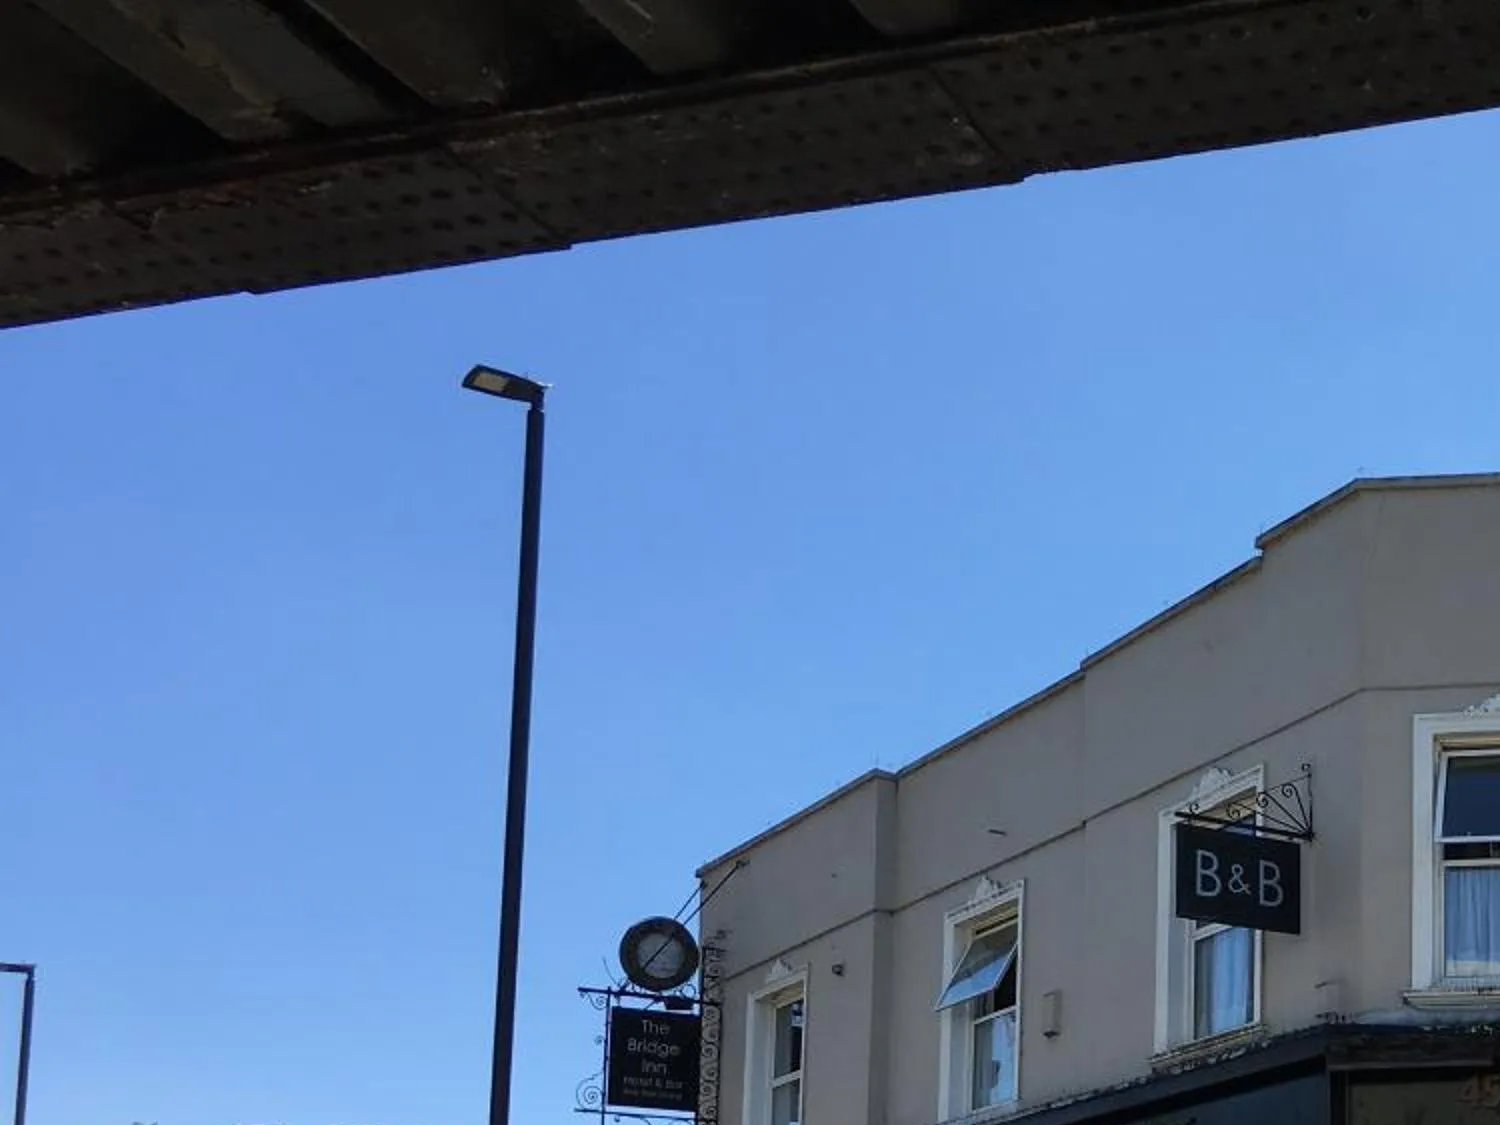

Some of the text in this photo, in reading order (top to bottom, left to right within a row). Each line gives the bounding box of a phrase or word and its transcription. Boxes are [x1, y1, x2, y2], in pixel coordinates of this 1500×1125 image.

[1196, 849, 1285, 907] B&B
[641, 1019, 671, 1036] The
[627, 1036, 682, 1059] Bridge
[641, 1059, 669, 1076] Inn
